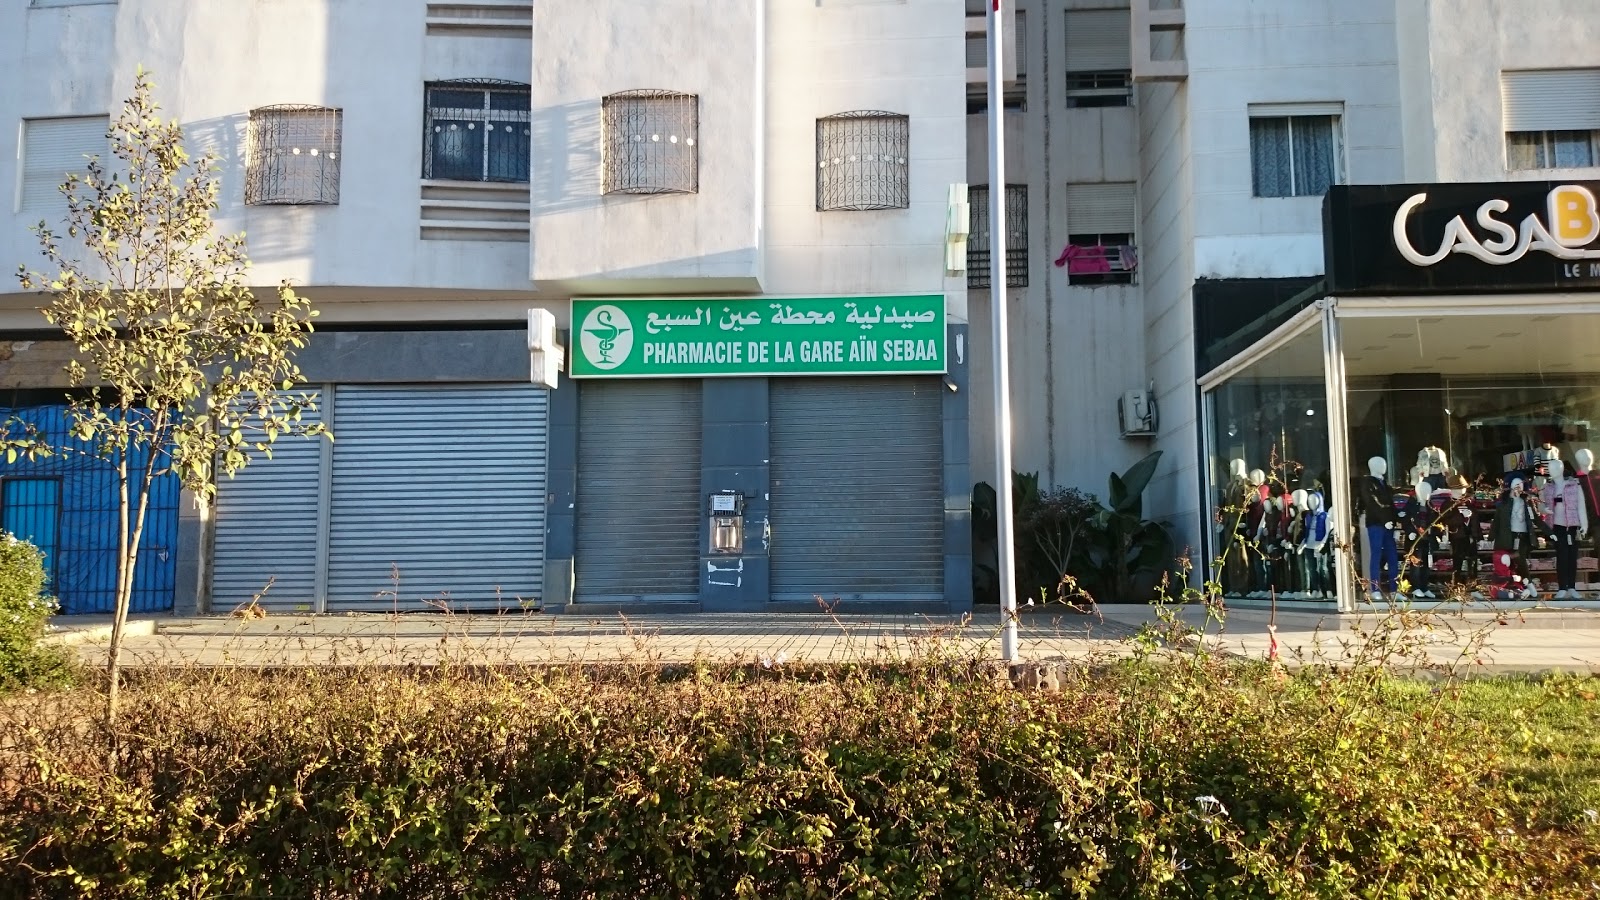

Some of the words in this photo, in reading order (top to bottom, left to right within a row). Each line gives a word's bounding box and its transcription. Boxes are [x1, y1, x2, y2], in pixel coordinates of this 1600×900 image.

[1564, 263, 1581, 278] LE
[646, 306, 711, 334] السبع
[720, 306, 761, 331] عين
[769, 303, 836, 325] محطة
[844, 301, 936, 330] صيدلية
[643, 341, 742, 364] PHARMACIE
[748, 341, 769, 363] DE
[774, 341, 795, 363] LA
[800, 340, 844, 362] GARE
[849, 334, 877, 361] AÏN
[883, 339, 938, 361] SEBAA
